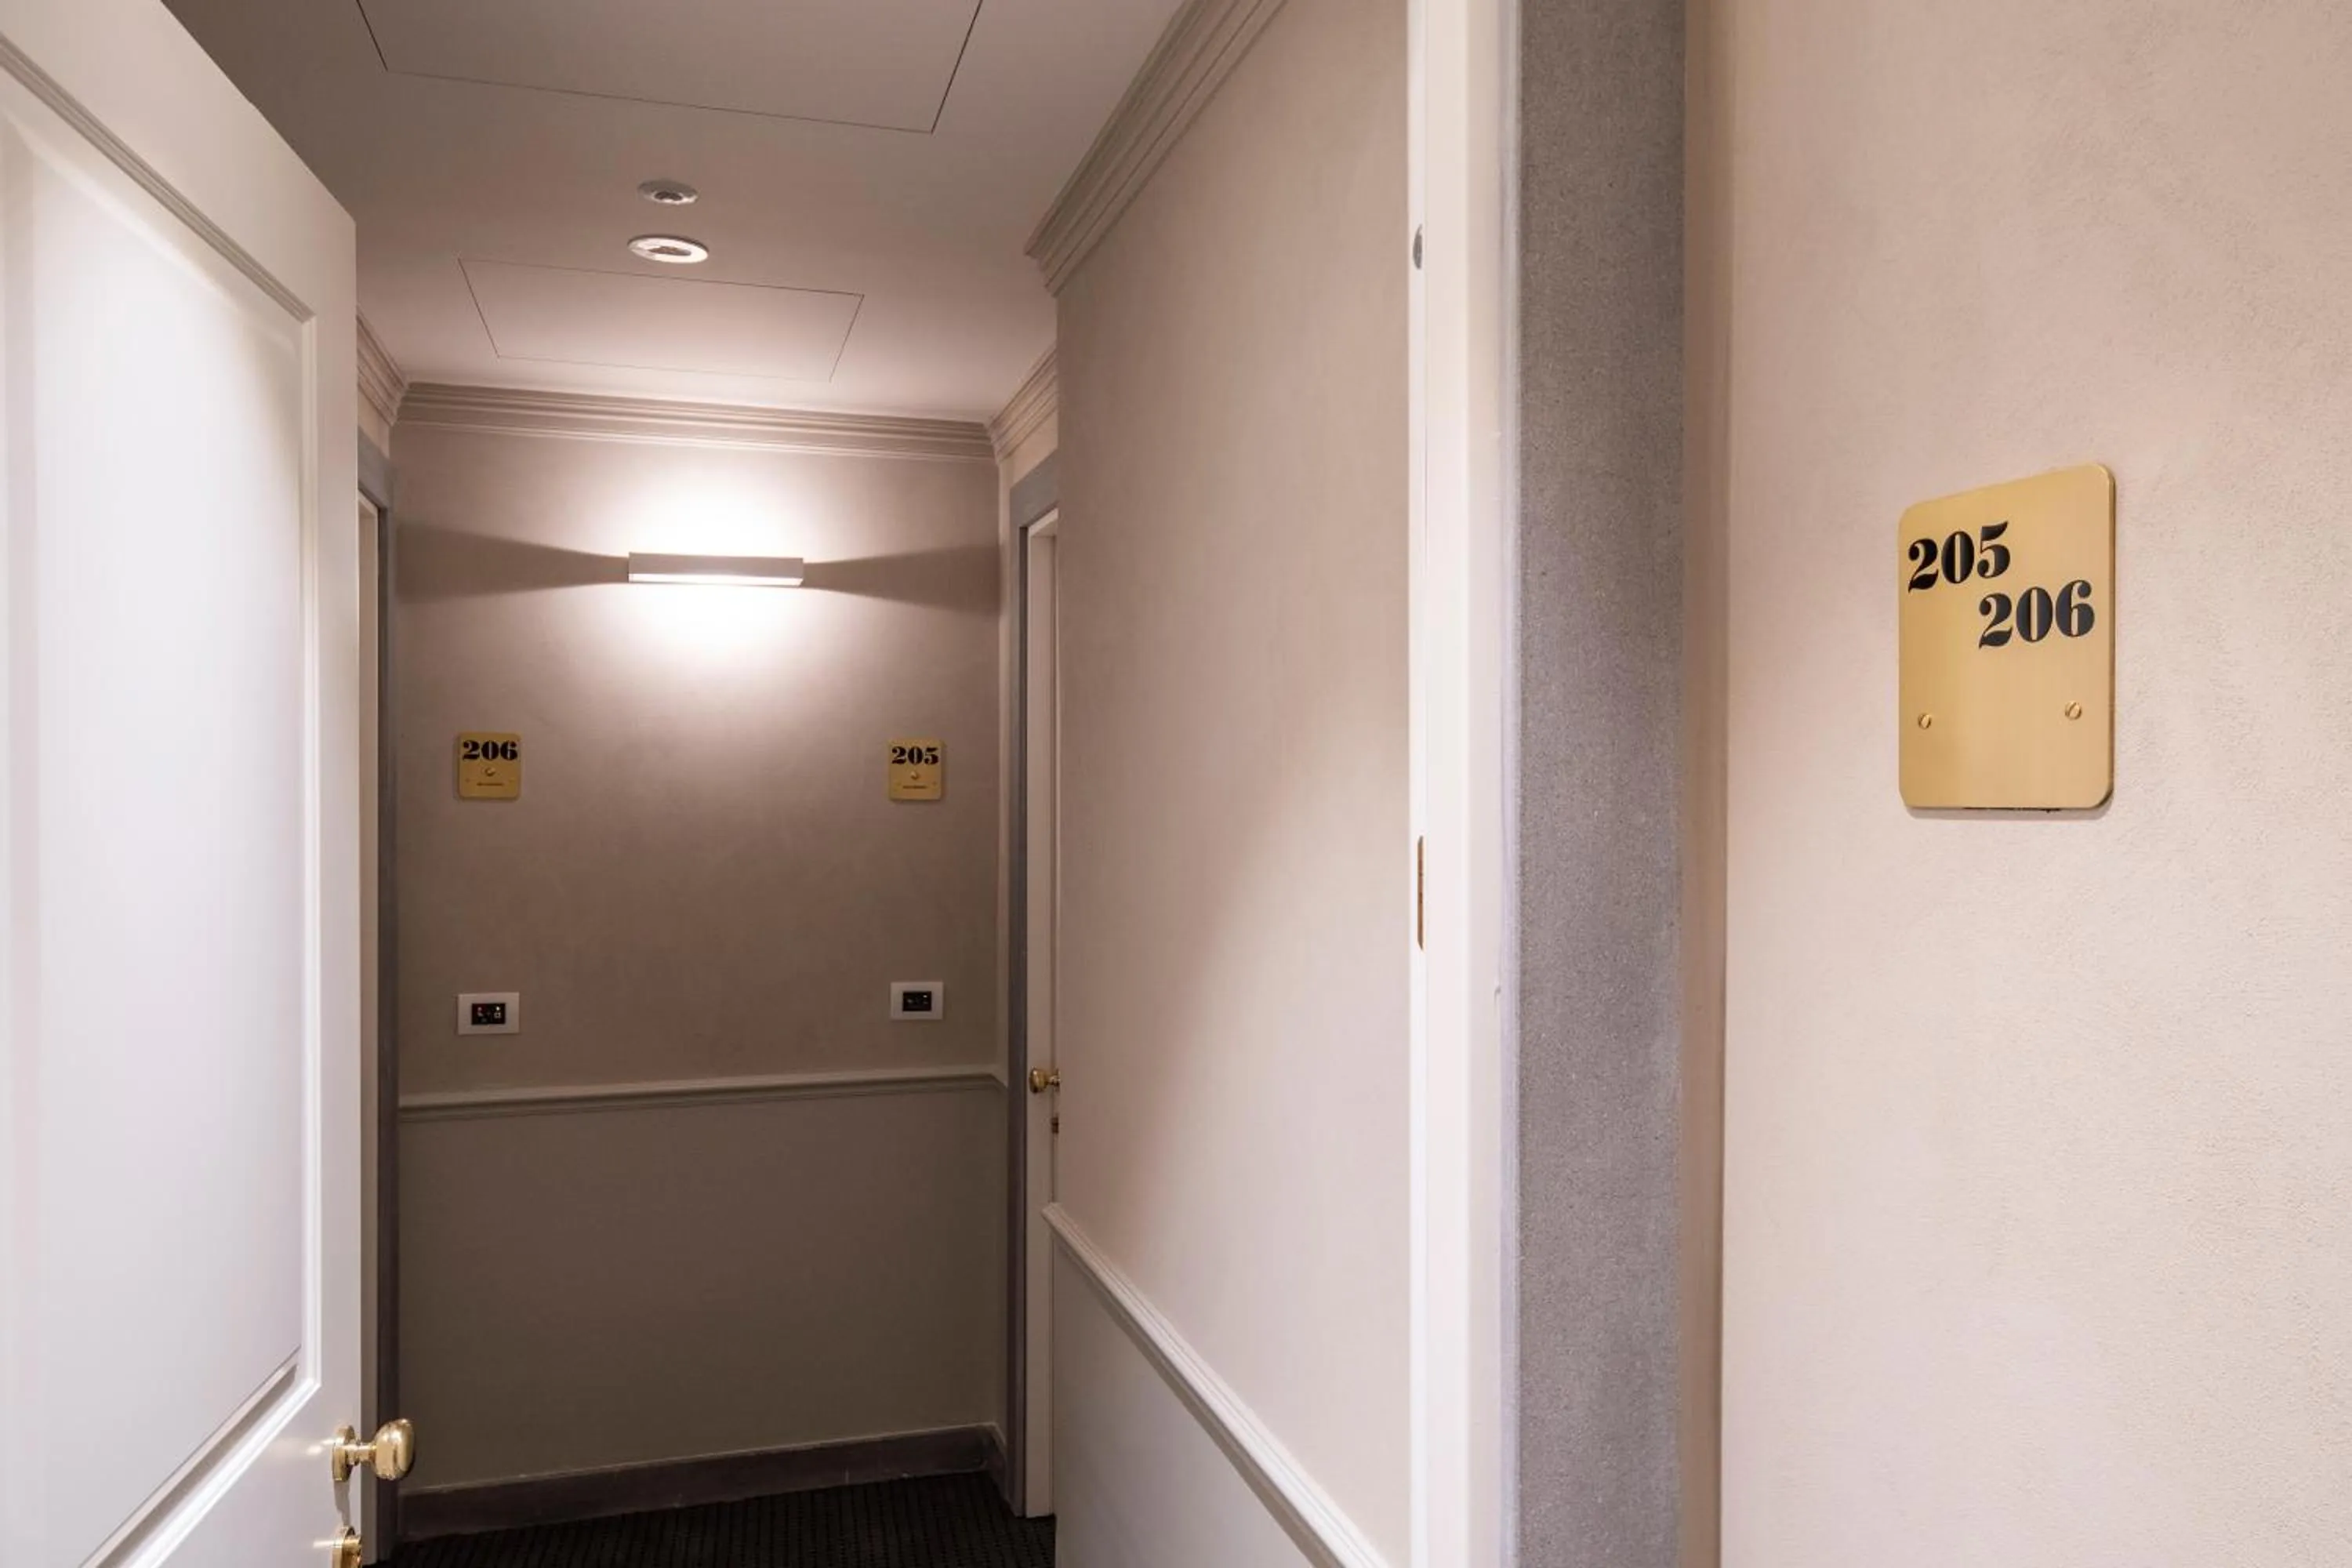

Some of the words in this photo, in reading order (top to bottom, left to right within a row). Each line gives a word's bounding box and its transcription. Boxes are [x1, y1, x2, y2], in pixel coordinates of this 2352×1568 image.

[1908, 521, 2010, 593] 205
[1979, 579, 2095, 648] 206
[463, 740, 518, 761] 206
[891, 746, 939, 765] 205
